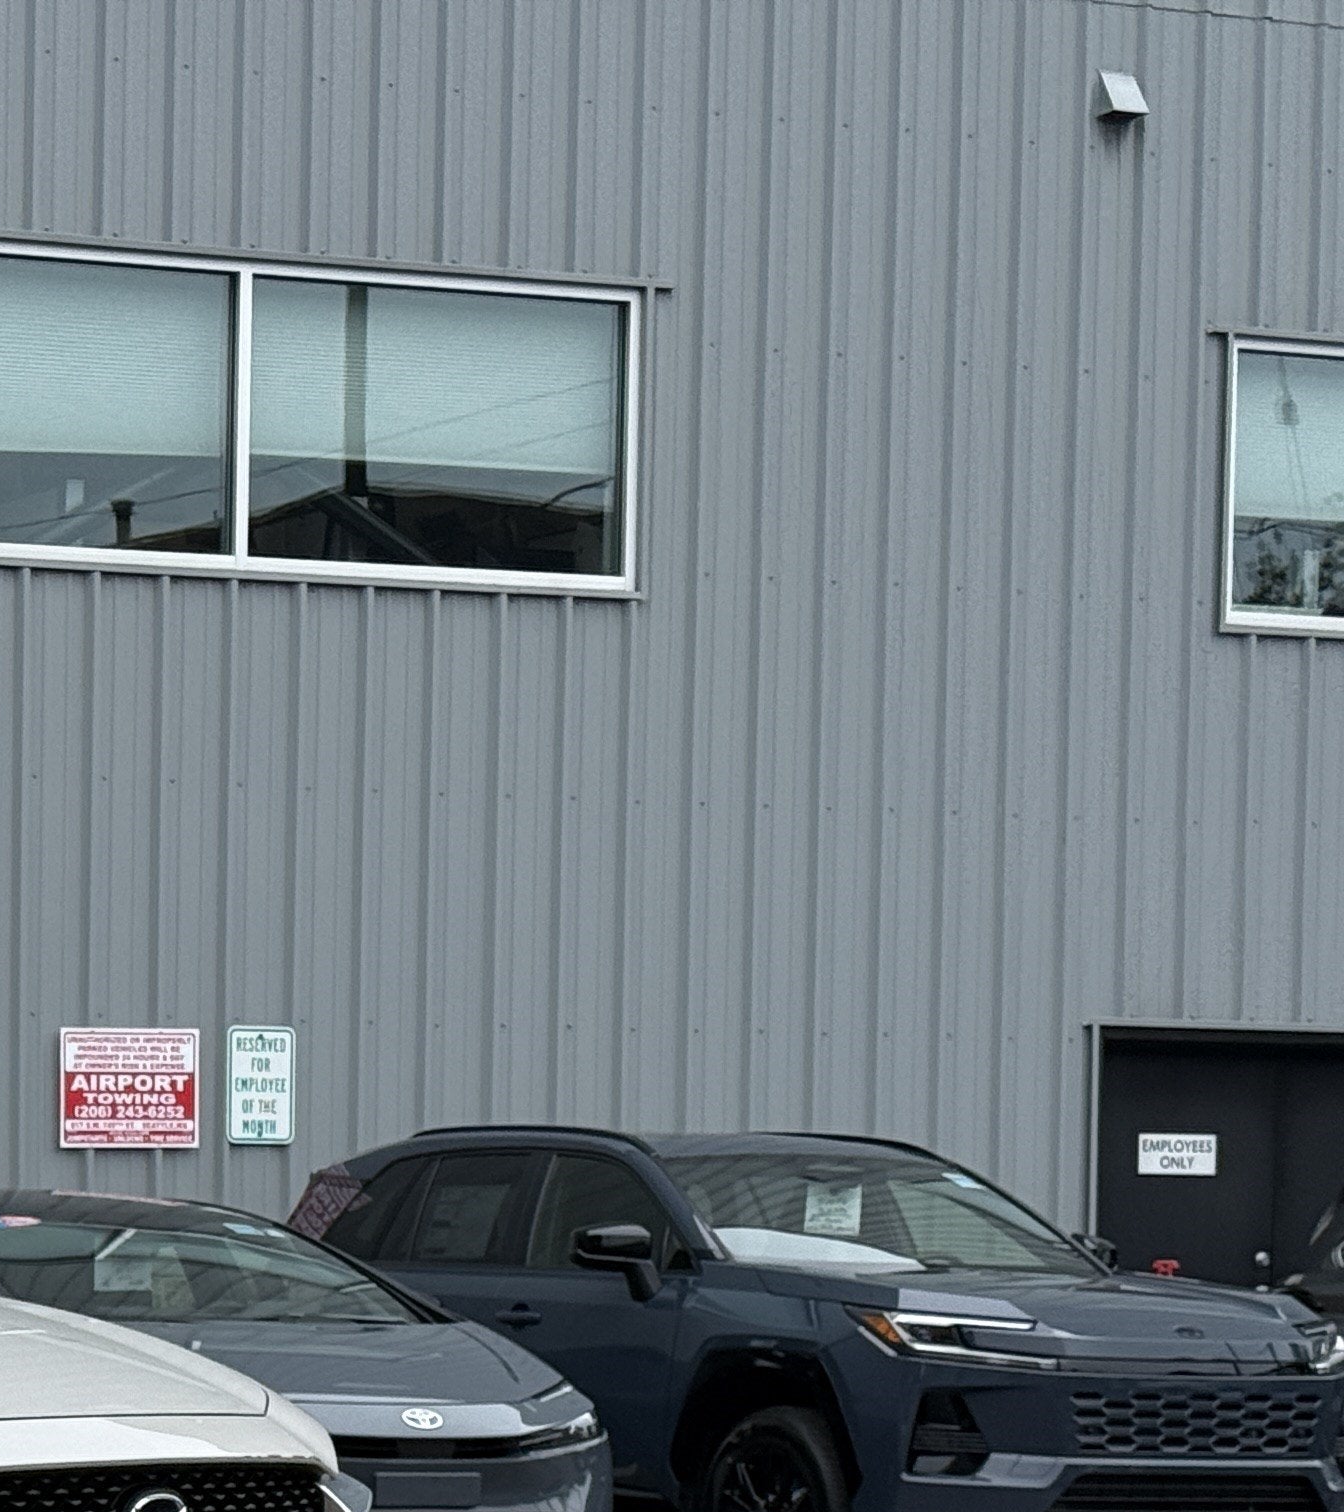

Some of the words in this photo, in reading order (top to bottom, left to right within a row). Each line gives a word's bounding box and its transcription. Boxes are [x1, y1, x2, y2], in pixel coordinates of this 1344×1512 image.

[235, 1037, 287, 1052] RESERVED
[251, 1057, 271, 1072] FOR
[70, 1074, 189, 1092] AIRPORT
[234, 1077, 287, 1092] EMPLOYEE
[83, 1092, 176, 1105] TOWING
[241, 1098, 254, 1113] OF
[258, 1098, 277, 1114] THE
[74, 1105, 112, 1118] (206)
[116, 1106, 185, 1119] 243-6252
[242, 1119, 277, 1134] MONTH
[1142, 1139, 1213, 1153] EMPLOYEES
[1159, 1156, 1195, 1170] ONLY
